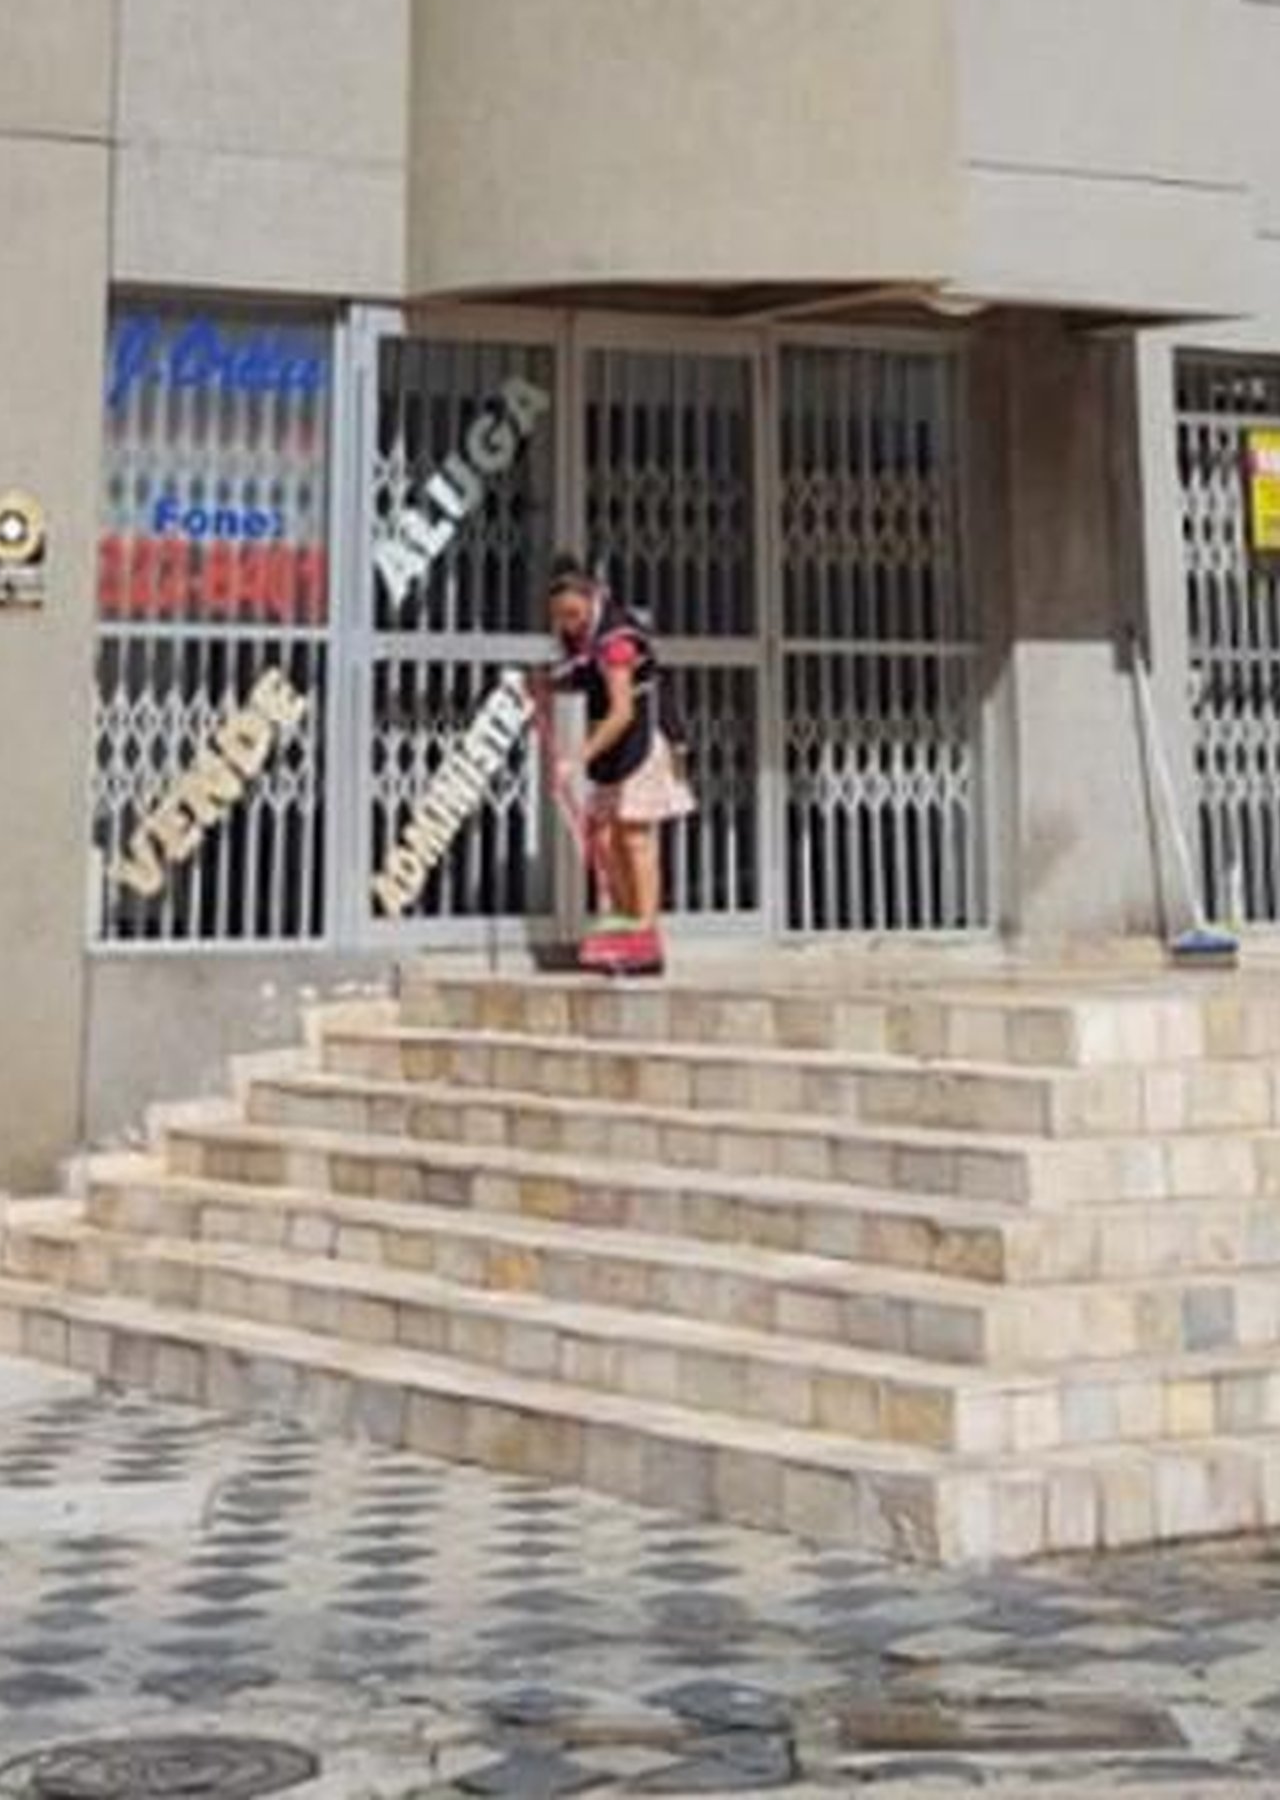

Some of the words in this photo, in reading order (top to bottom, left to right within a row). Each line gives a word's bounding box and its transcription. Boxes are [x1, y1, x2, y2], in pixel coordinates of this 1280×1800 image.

[153, 496, 285, 539] Fone:
[375, 374, 551, 606] ALUGA
[108, 666, 306, 897] VENDE
[372, 668, 536, 917] ADMINISTRA
